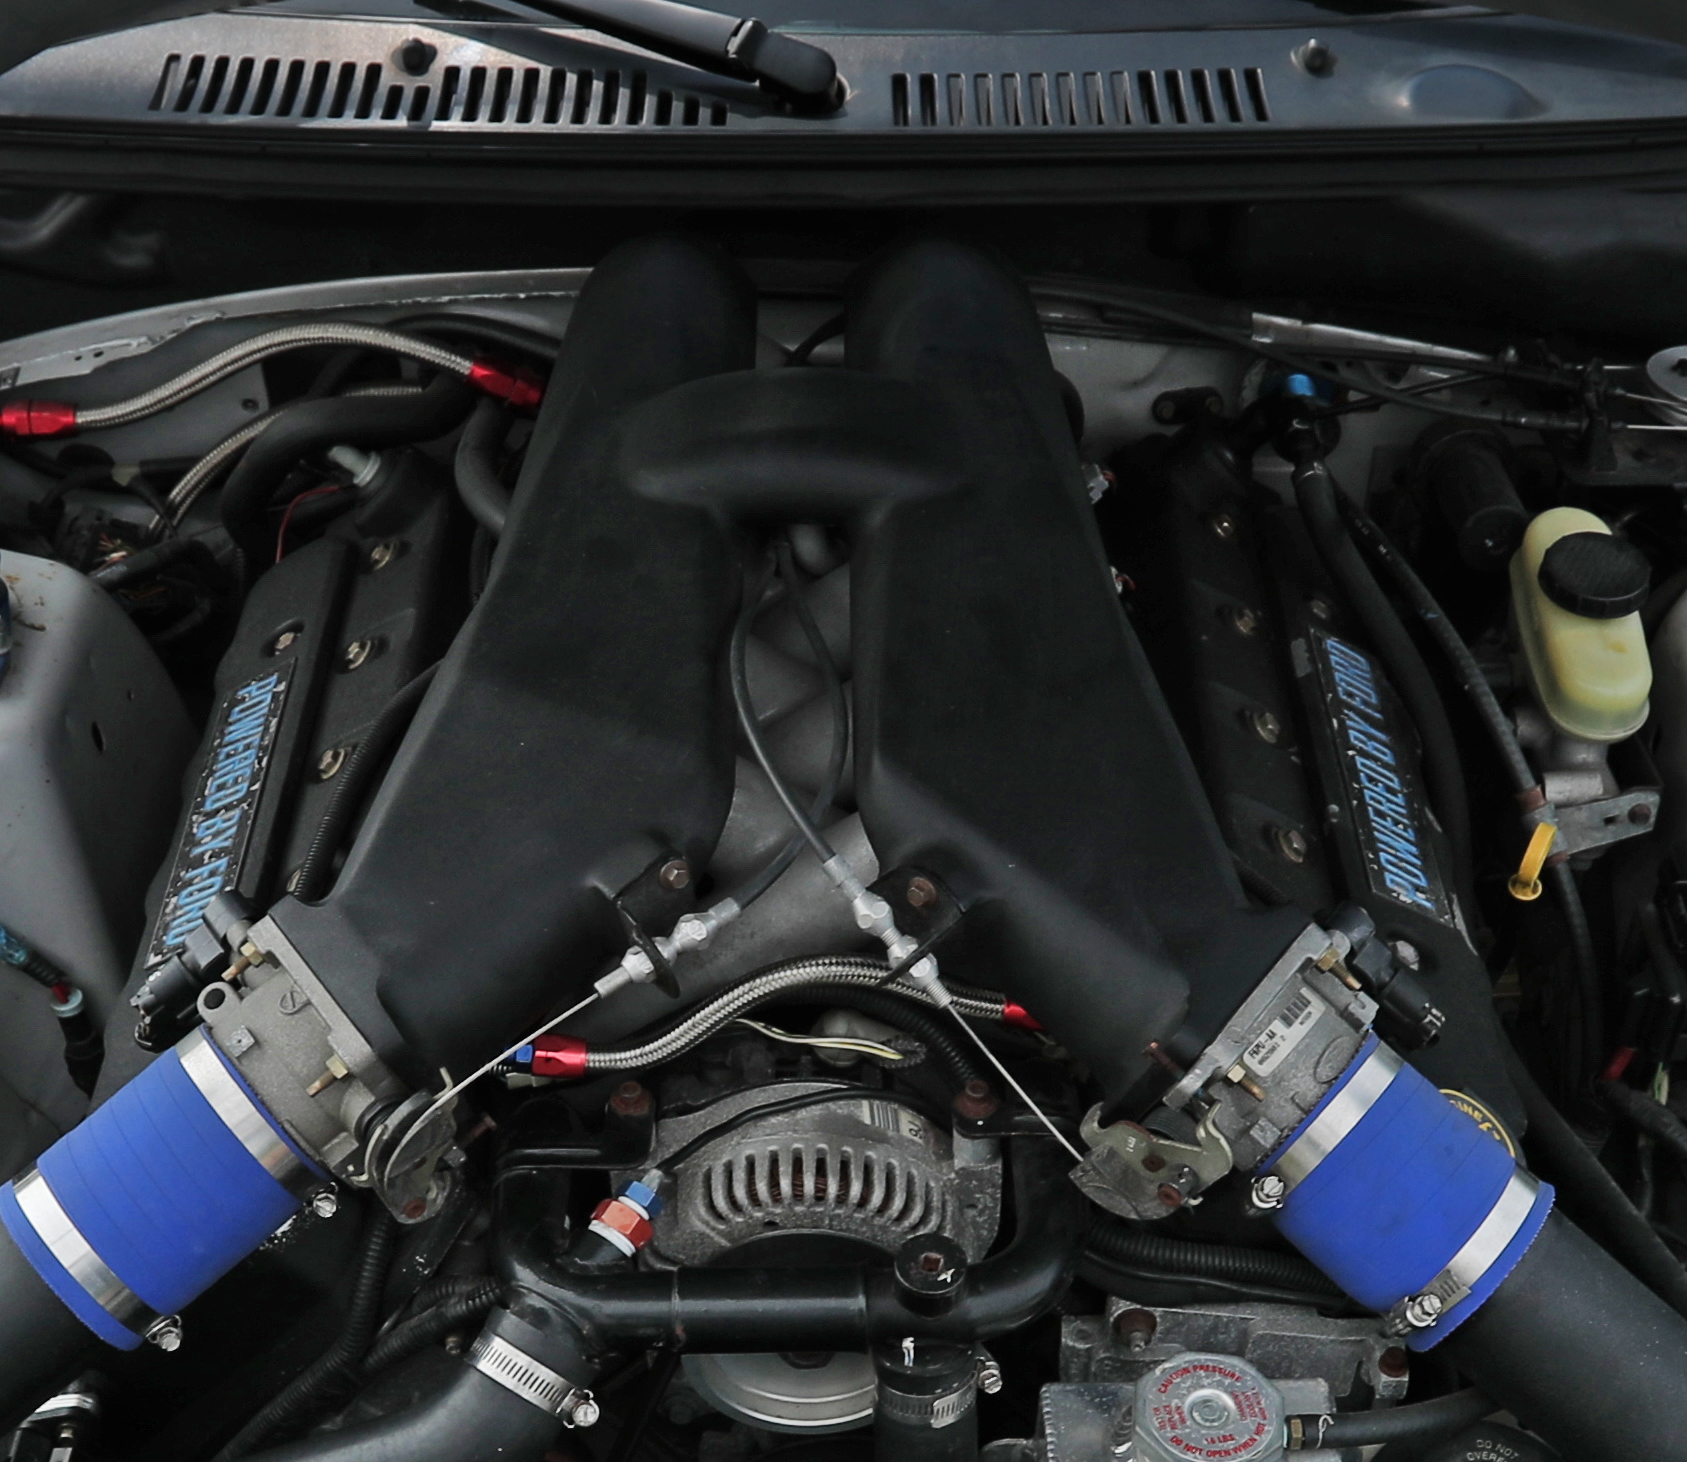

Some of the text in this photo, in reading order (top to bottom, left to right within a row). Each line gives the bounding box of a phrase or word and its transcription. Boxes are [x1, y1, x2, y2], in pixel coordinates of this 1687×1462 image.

[204, 673, 279, 811] POWERED
[1326, 639, 1435, 909] POWERED BY FORD
[190, 810, 243, 856] BY
[1192, 1365, 1242, 1382] PRESSURE
[1170, 1435, 1184, 1446] DO
[1183, 1443, 1204, 1456] NOT
[1206, 1449, 1232, 1458] OPEN
[1232, 1436, 1258, 1454] WHEN
[1476, 1439, 1519, 1459] DO NOT
